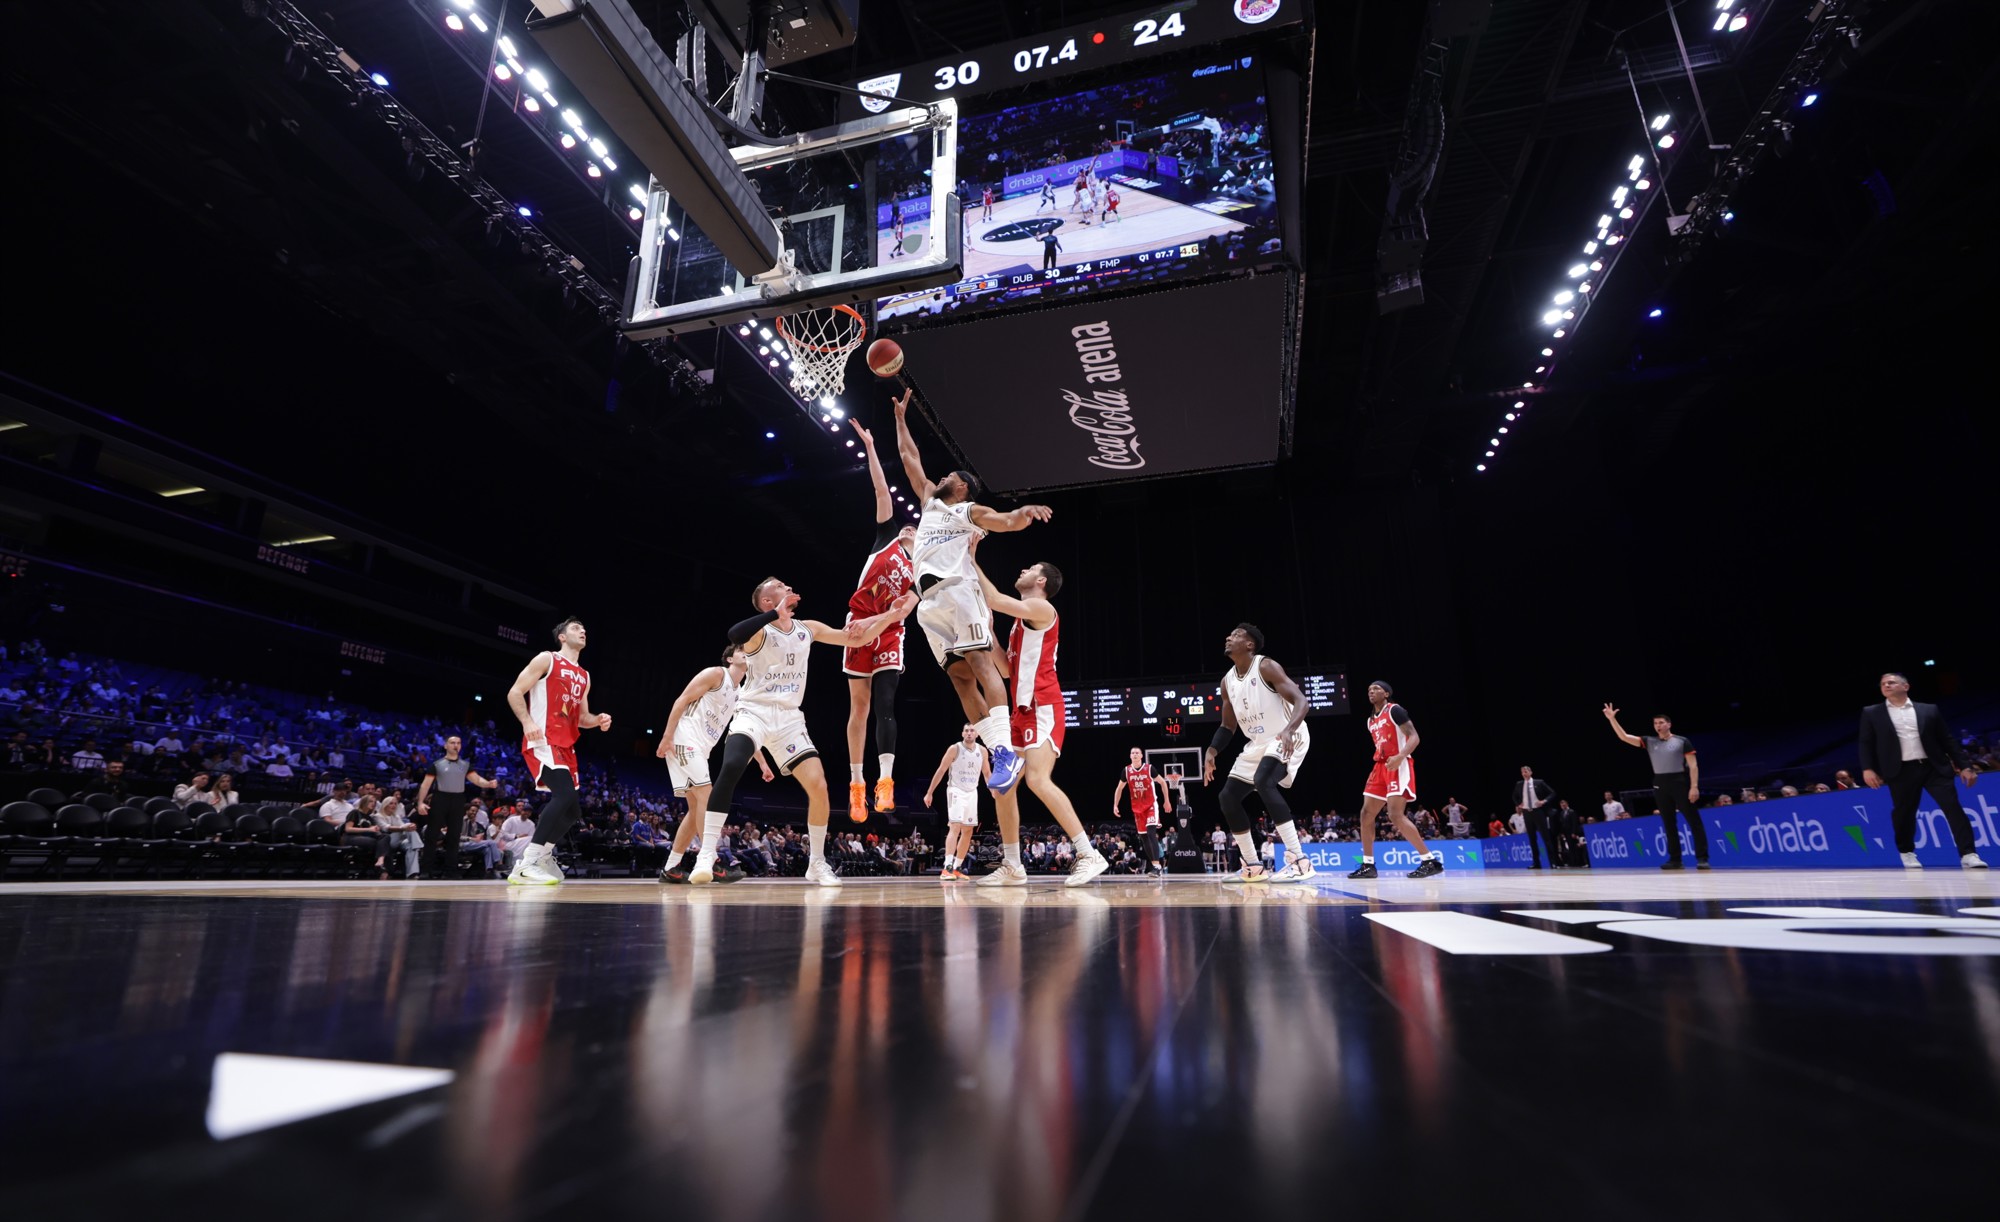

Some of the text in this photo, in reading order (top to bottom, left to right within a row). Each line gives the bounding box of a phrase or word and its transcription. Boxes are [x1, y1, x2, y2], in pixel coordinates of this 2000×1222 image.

[1133, 12, 1185, 46] 24
[1014, 38, 1078, 72] 07.4
[934, 60, 980, 91] 30
[1173, 114, 1200, 126] OMNIYAT
[1009, 172, 1044, 190] dnata
[1013, 245, 1198, 284] DUB 30 24 FMP Q1 07.7 4.6
[1055, 276, 1074, 284] ROUND
[1059, 320, 1146, 470] Coca-Cola arena
[257, 545, 310, 574] DEFENSE
[498, 625, 528, 645] DEFENSE
[968, 623, 984, 641] 10
[340, 641, 387, 665] DEFENSE
[786, 652, 795, 666] 13
[879, 650, 898, 665] 22
[570, 681, 582, 697] 10
[1163, 687, 1221, 699] 30 2
[1180, 696, 1204, 706] 07.3
[1024, 728, 1034, 742] 0
[1166, 724, 1180, 734] 40
[1375, 731, 1380, 740] 5
[1390, 781, 1398, 791] 5
[1748, 812, 1829, 853] dnata
[1174, 849, 1197, 857] dnata
[1484, 846, 1500, 863] dnata
[1591, 833, 1629, 859] dnata
[1383, 847, 1444, 865] dnaa
